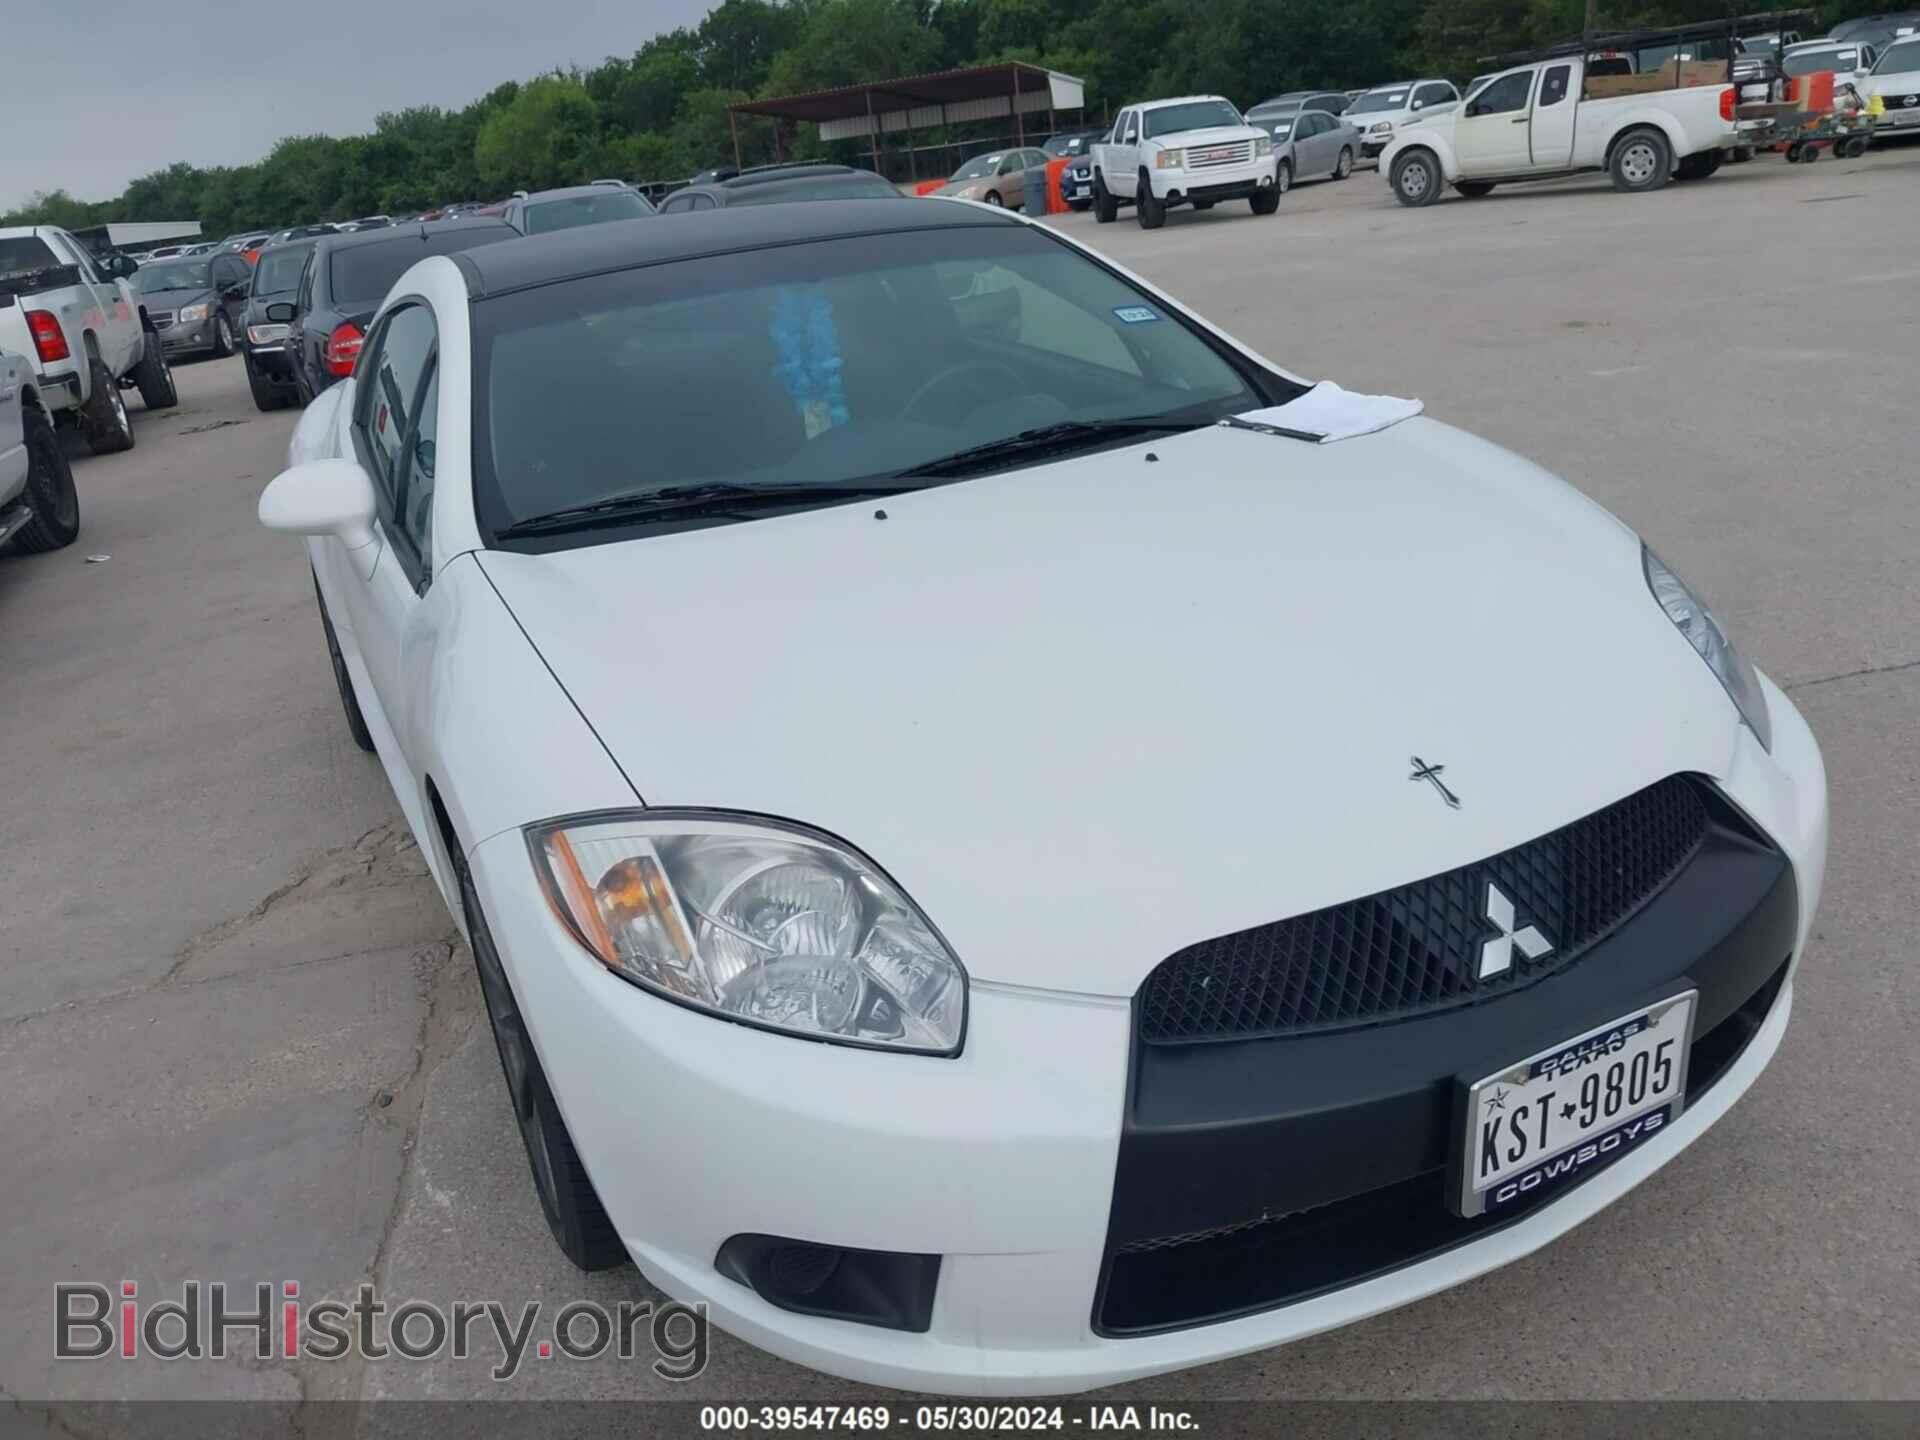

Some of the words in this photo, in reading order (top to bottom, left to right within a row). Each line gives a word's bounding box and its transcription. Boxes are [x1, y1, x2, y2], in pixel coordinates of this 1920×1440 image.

[1540, 1023, 1640, 1073] DALLAS
[1481, 1092, 1556, 1178] KST
[1579, 1038, 1675, 1129] 9805
[1496, 1112, 1664, 1203] COWBOYS
